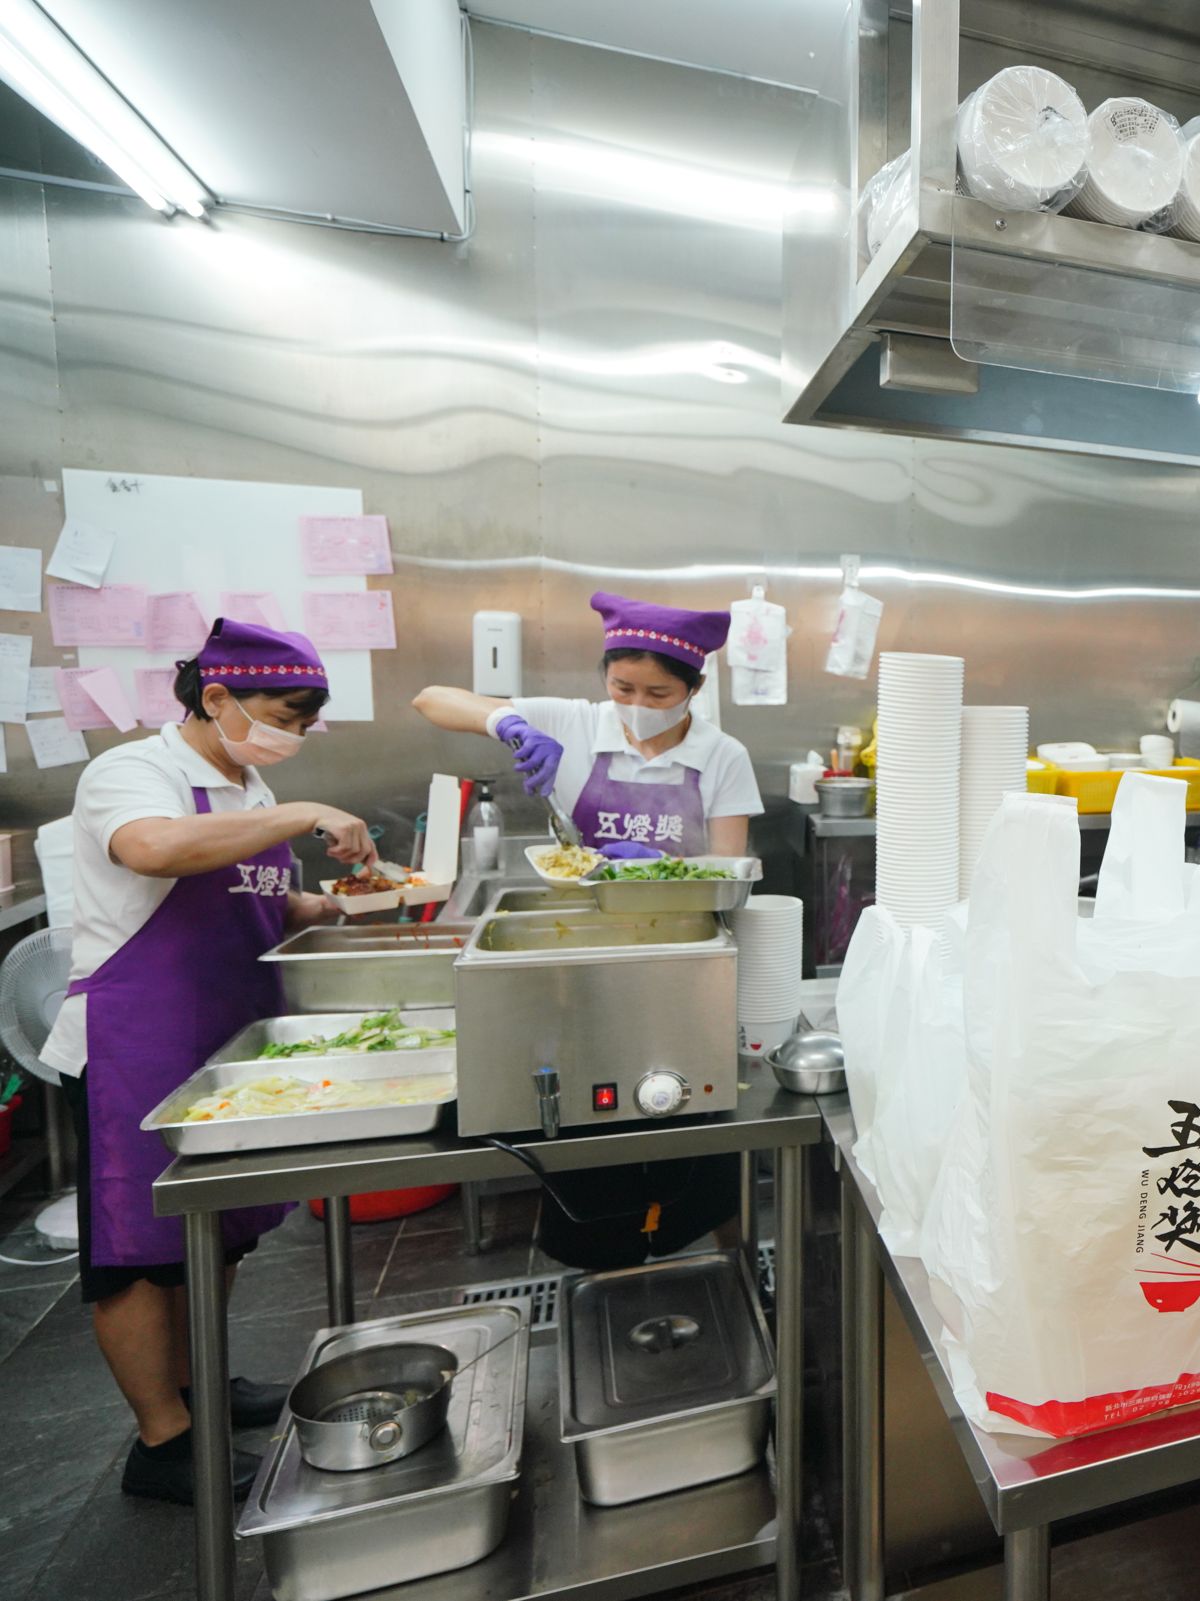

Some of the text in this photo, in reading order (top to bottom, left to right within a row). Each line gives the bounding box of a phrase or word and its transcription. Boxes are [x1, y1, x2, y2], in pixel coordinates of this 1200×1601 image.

[594, 812, 683, 843] 五燈獎
[1135, 1169, 1150, 1254] WU DENG JIANG
